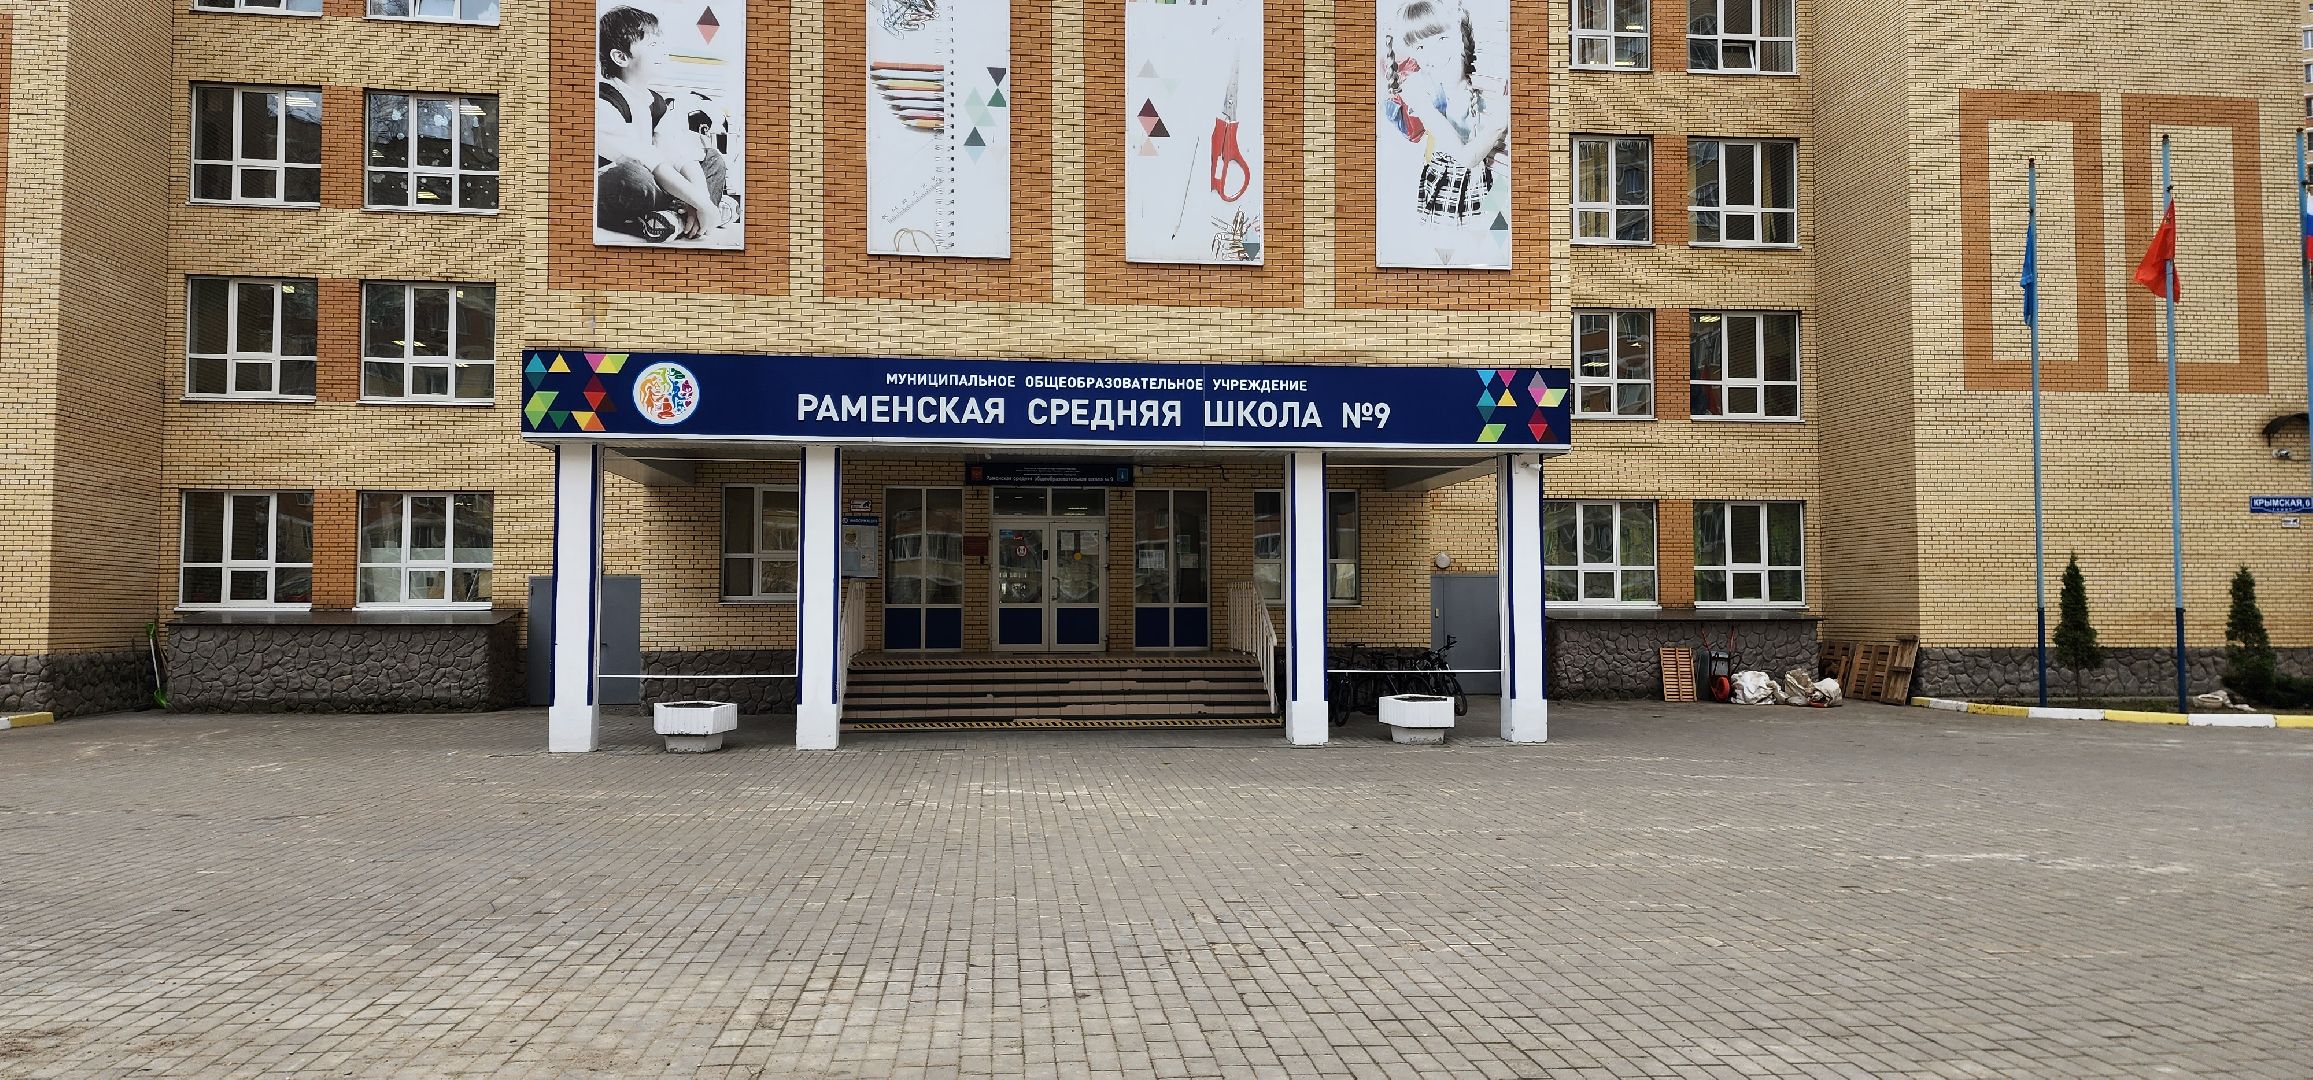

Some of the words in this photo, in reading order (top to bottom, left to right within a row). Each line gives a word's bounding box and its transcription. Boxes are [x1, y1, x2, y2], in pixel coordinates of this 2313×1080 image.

[886, 373, 1016, 388] МУНИЦИПАЛЬНОЕ
[1025, 375, 1204, 391] ОБЩЕОБРАЗОВАТЕЛЬНОЕ
[1212, 378, 1308, 393] УЧРЕЖДЕНИЕ
[797, 393, 1005, 424] РАМЕНСКАЯ
[1027, 397, 1182, 431] СРЕДНЯЯ
[1204, 400, 1323, 428] ШКОЛА
[1342, 402, 1391, 429] №9
